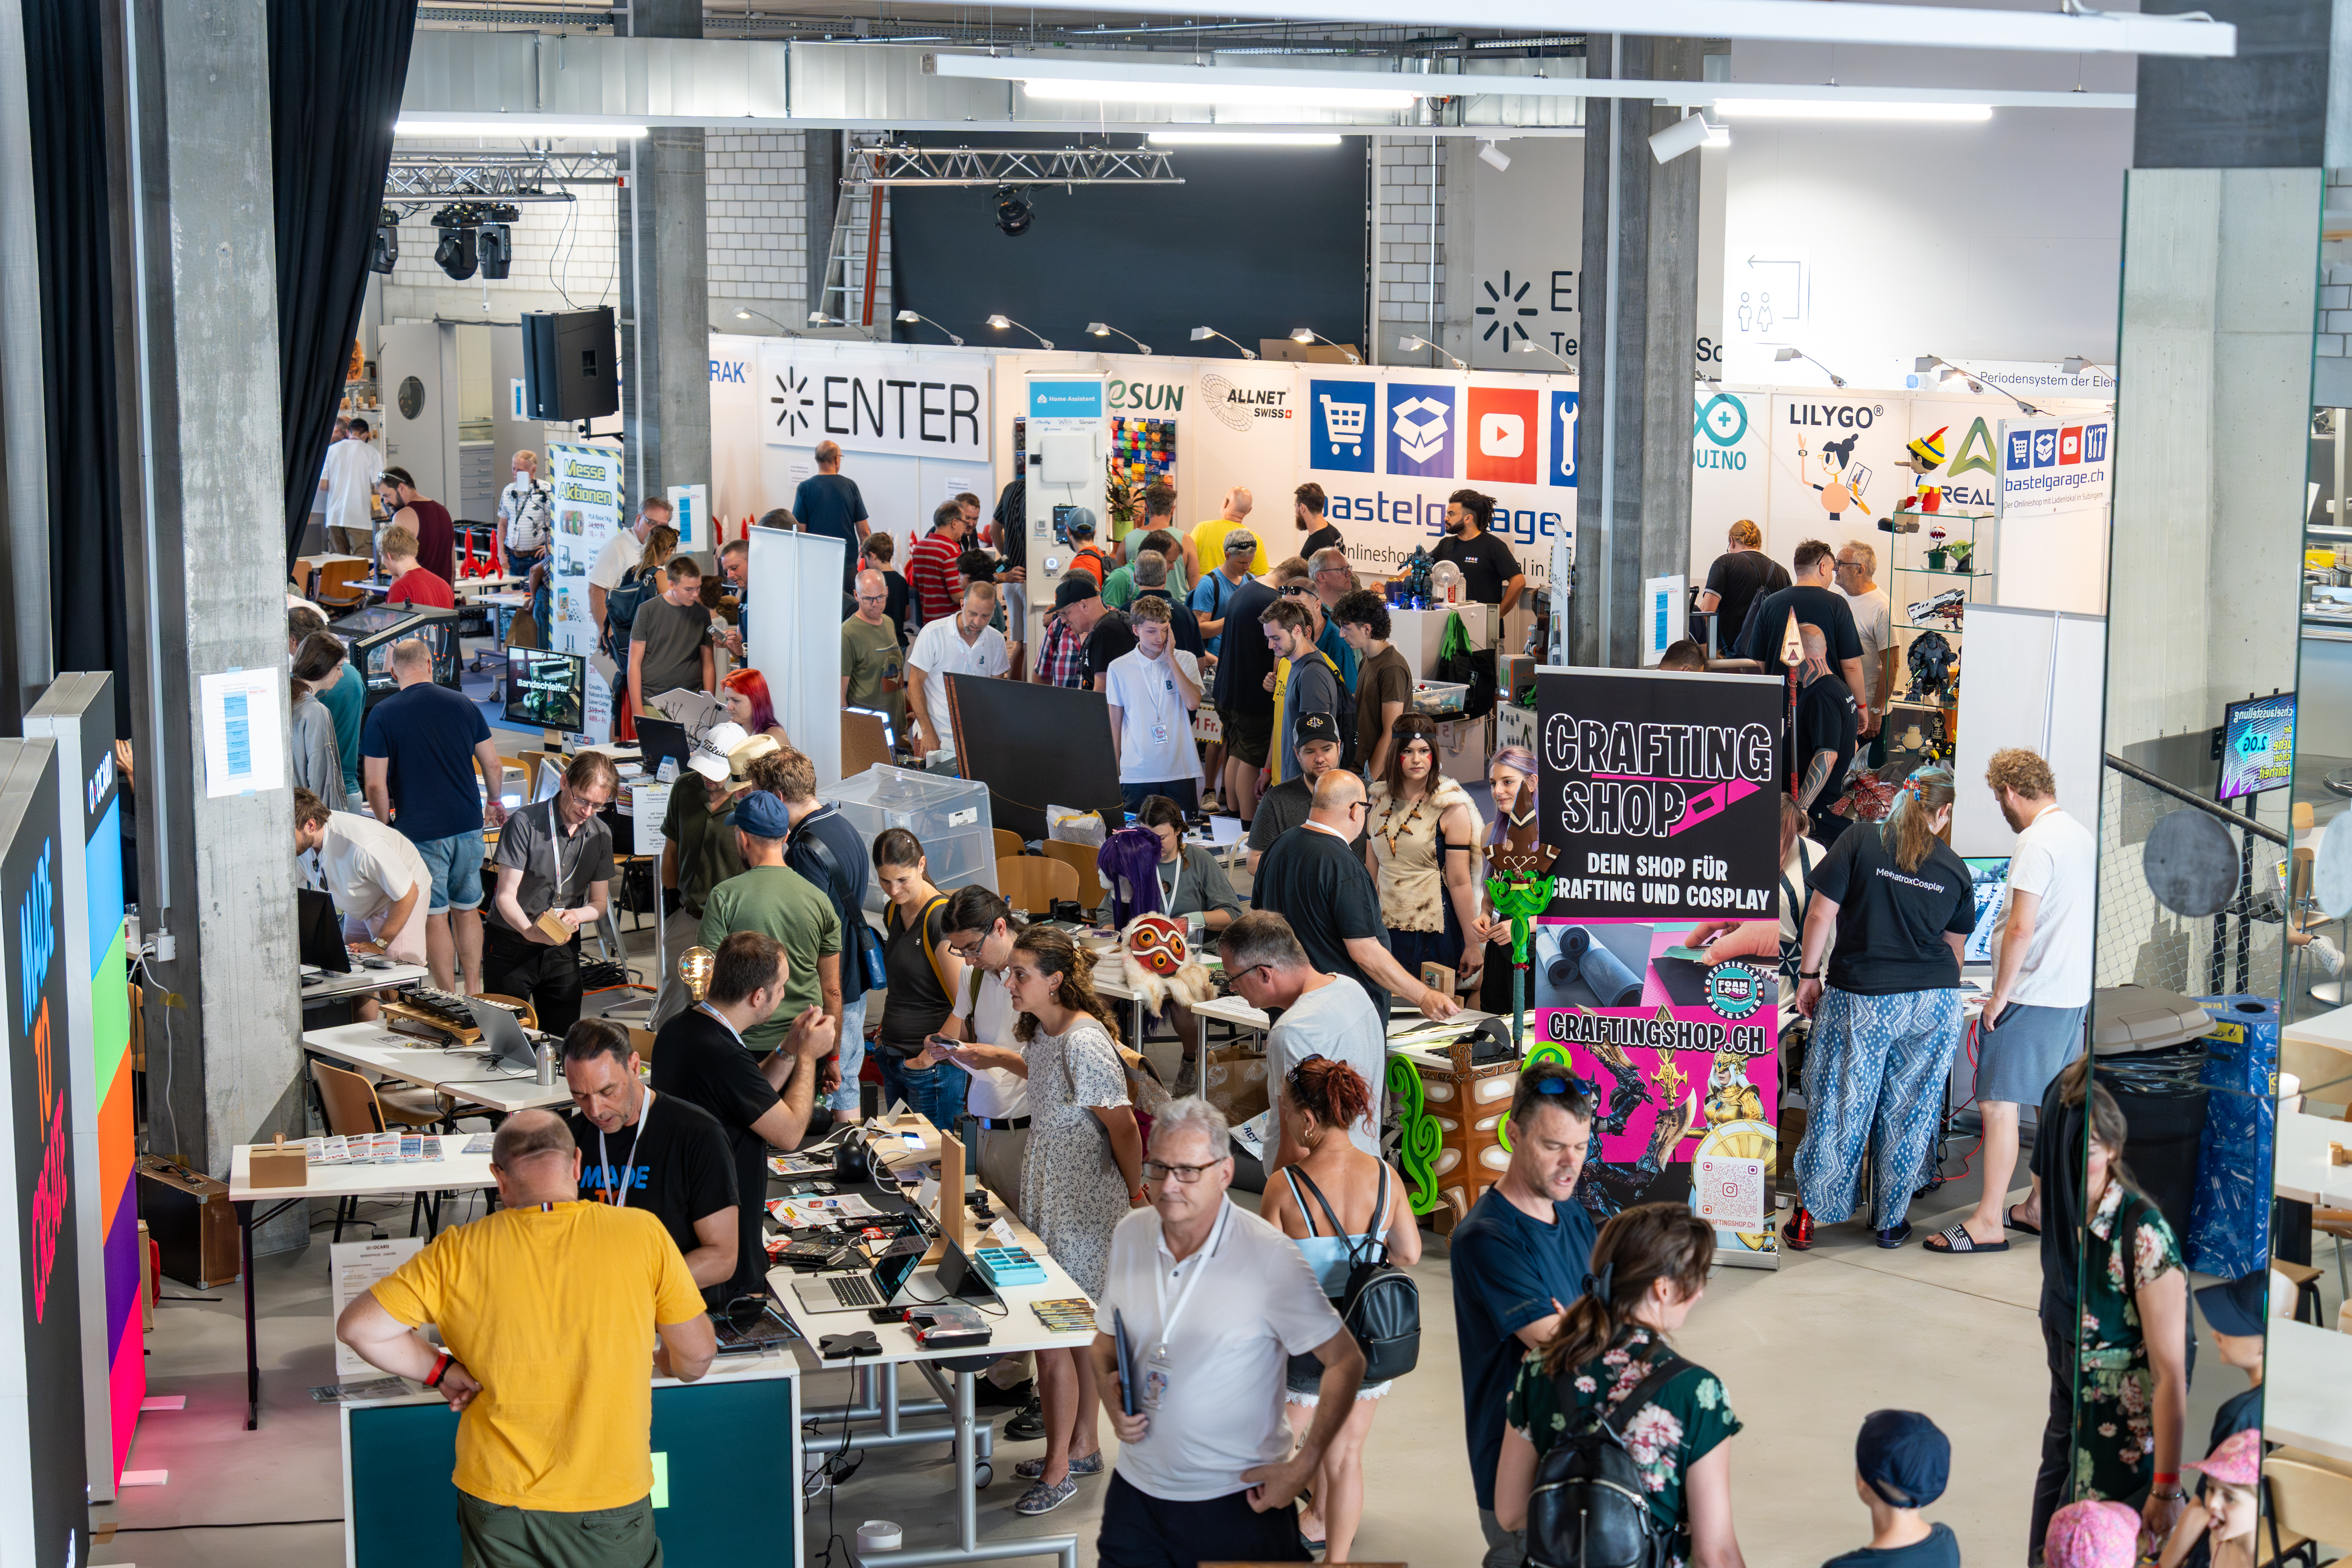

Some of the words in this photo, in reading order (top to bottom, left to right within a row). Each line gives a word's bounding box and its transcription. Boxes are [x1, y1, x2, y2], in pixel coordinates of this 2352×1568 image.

[1980, 372, 2068, 387] Periodensystem
[2071, 375, 2085, 386] der
[1227, 388, 1287, 406] ALLNET
[824, 376, 979, 446] ENTER
[1254, 407, 1284, 418] SWISS
[1790, 404, 1873, 429] LILYGO
[564, 458, 606, 482] Messe
[1692, 450, 1746, 471] UINO
[2005, 469, 2104, 492] bastelgarage.ch
[557, 481, 612, 506] Aktionen
[1941, 486, 1995, 506] REAL
[2014, 499, 2042, 509] Onlineshop
[2051, 494, 2076, 504] Ladenlokal
[2082, 492, 2103, 501] Subingen
[516, 678, 569, 693] Bandschleifer
[1204, 718, 1218, 733] Fr.
[1545, 713, 1772, 781] CRAFTING
[1561, 780, 1686, 837] SHOP
[1588, 852, 1629, 876] DEIN
[1636, 855, 1686, 879] SHOP
[1693, 855, 1728, 881] FÜR
[1552, 877, 1635, 903] CRAFTING
[1642, 883, 1680, 906] UND
[1686, 886, 1771, 911] COSPLAY
[21, 836, 54, 1037] MADE
[1705, 961, 1764, 989] OFFIZIELLER
[1718, 980, 1748, 988] FOAM
[1718, 987, 1748, 995] LORD
[1706, 995, 1762, 1019] RESELLER
[1548, 1011, 1766, 1054] CRAFTINGSHOP.CH
[35, 996, 52, 1144] TO
[580, 1165, 650, 1189] MADE
[32, 1088, 67, 1324] CREATE
